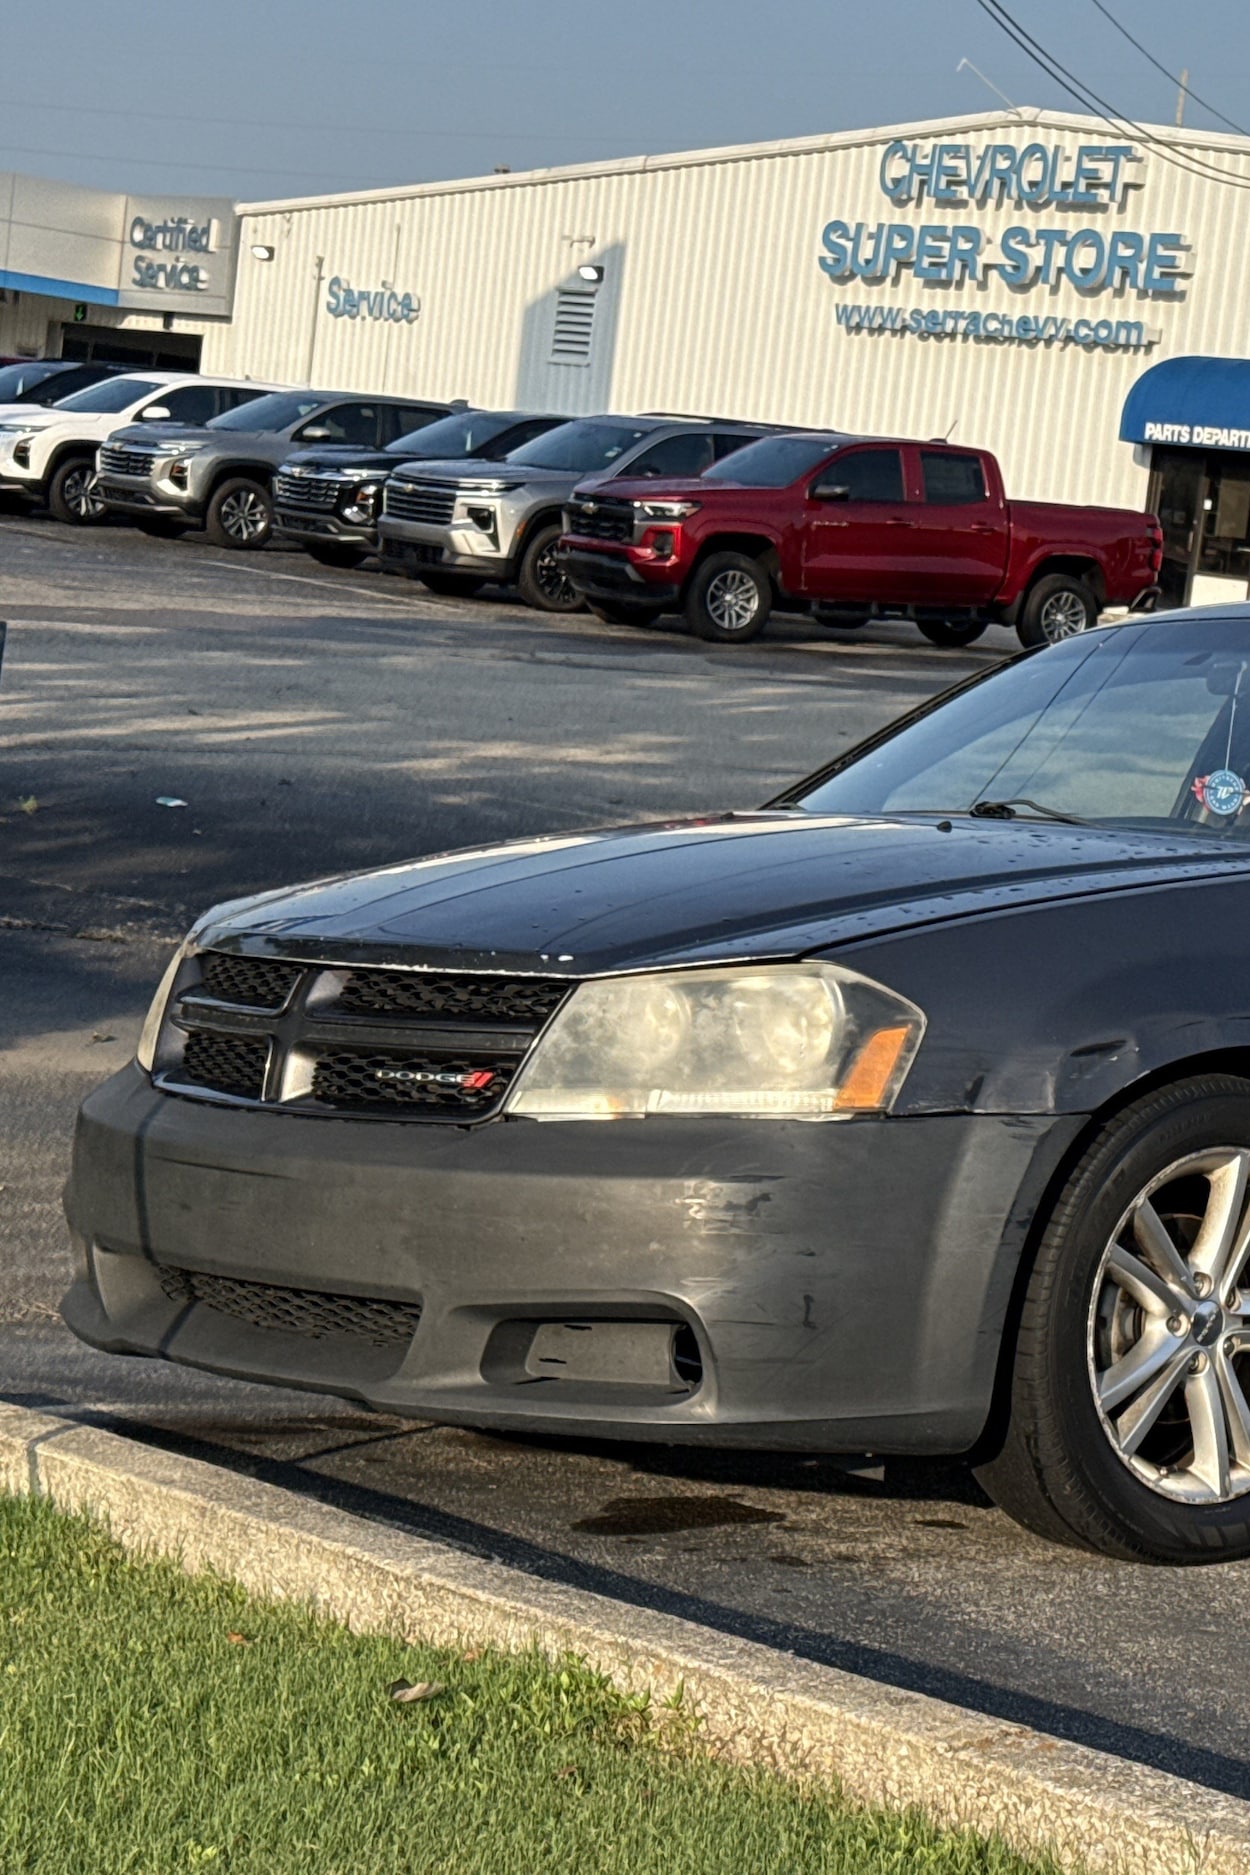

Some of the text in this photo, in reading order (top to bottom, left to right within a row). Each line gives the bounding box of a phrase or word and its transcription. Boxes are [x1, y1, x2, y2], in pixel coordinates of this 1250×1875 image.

[880, 140, 1140, 204] CHEVROLET
[130, 215, 213, 253] Certified
[133, 254, 207, 291] Service
[818, 219, 1187, 292] SUPER STORE
[326, 276, 420, 323] Service
[1144, 422, 1190, 443] PARTS
[376, 1069, 475, 1083] DODGE
